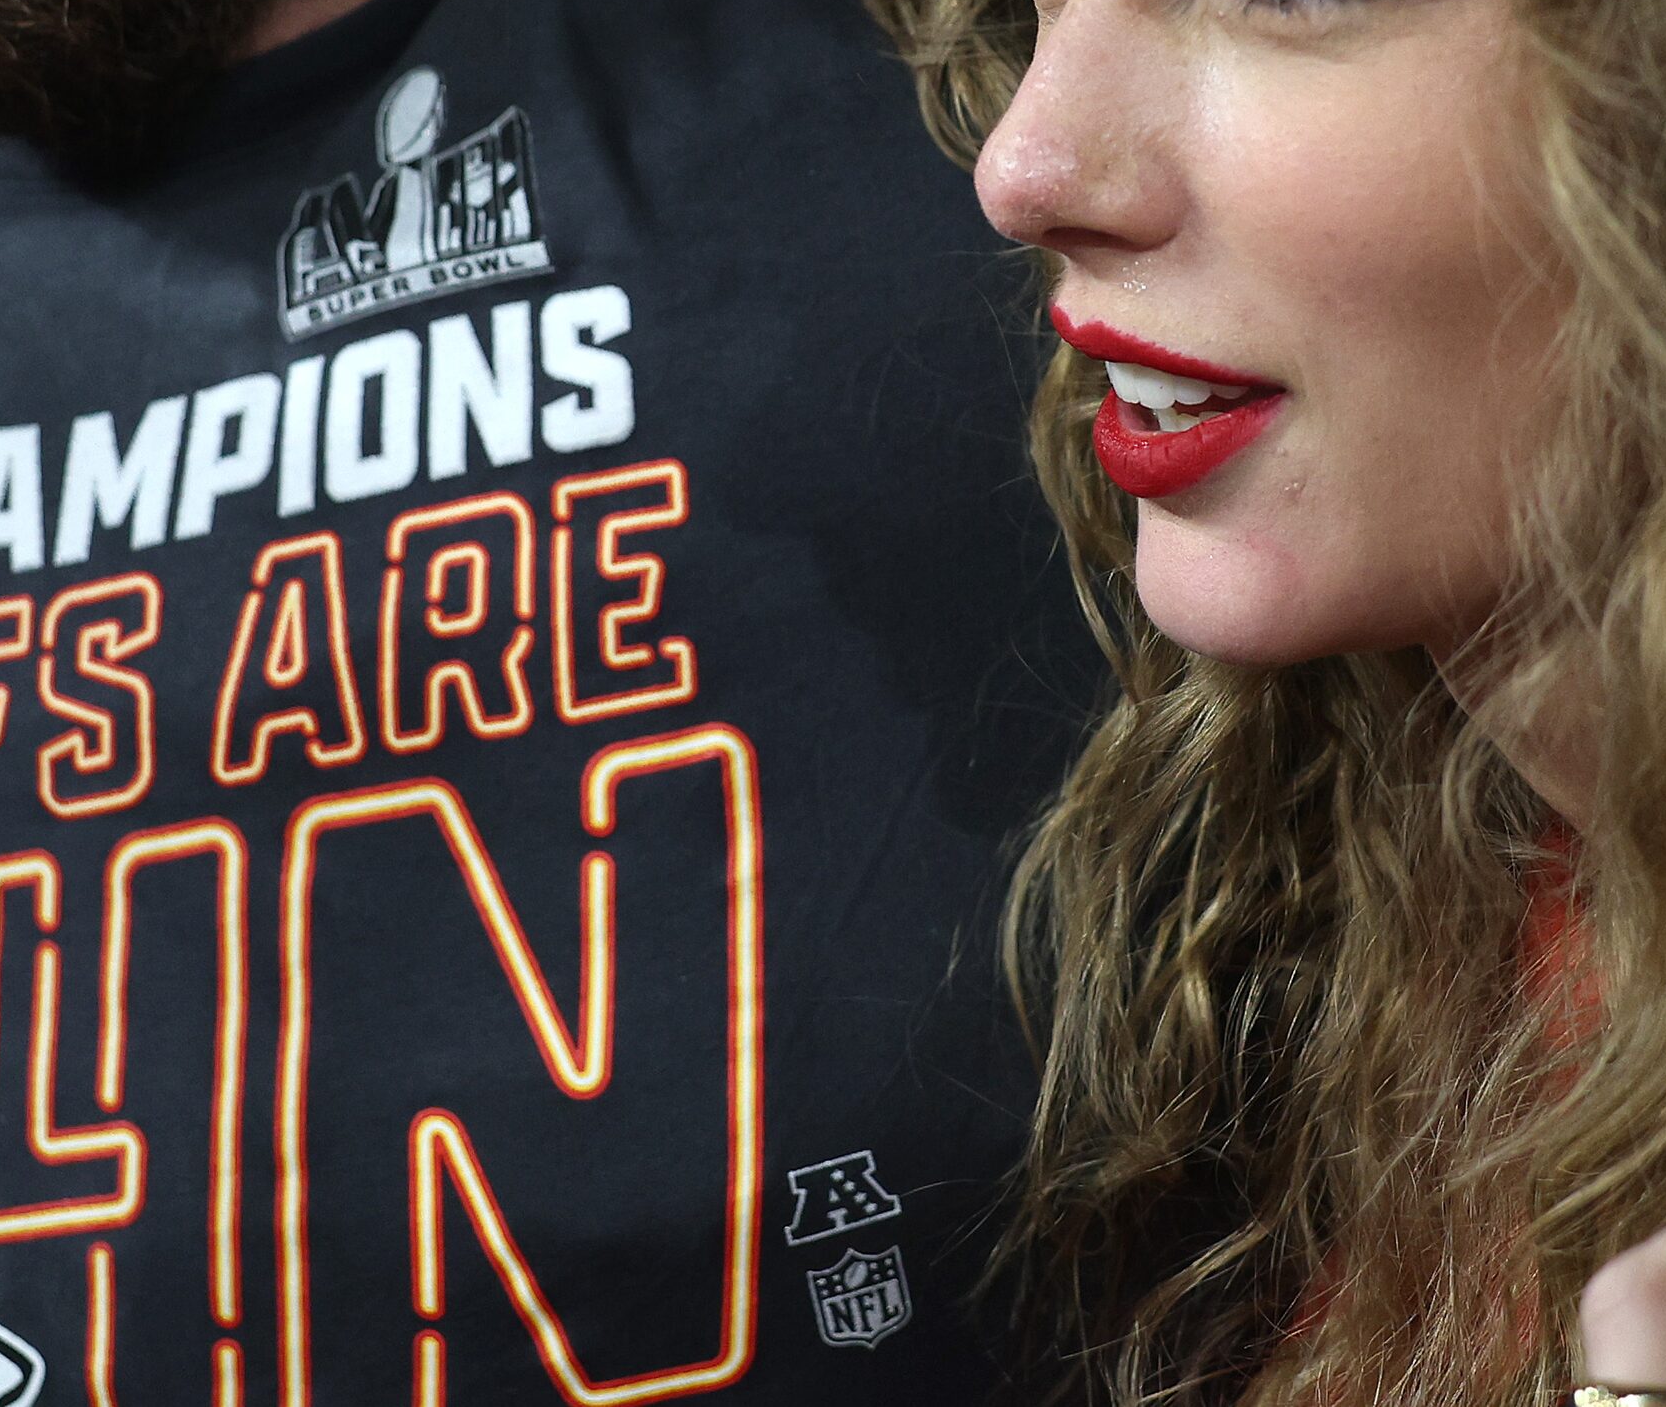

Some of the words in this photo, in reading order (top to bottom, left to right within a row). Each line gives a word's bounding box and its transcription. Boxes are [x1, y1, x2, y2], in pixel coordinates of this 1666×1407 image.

[307, 277, 409, 320] SUPER
[428, 249, 527, 285] BOWL
[211, 458, 698, 786] ARE
[85, 722, 765, 1407] IN
[827, 1287, 900, 1334] NFL
